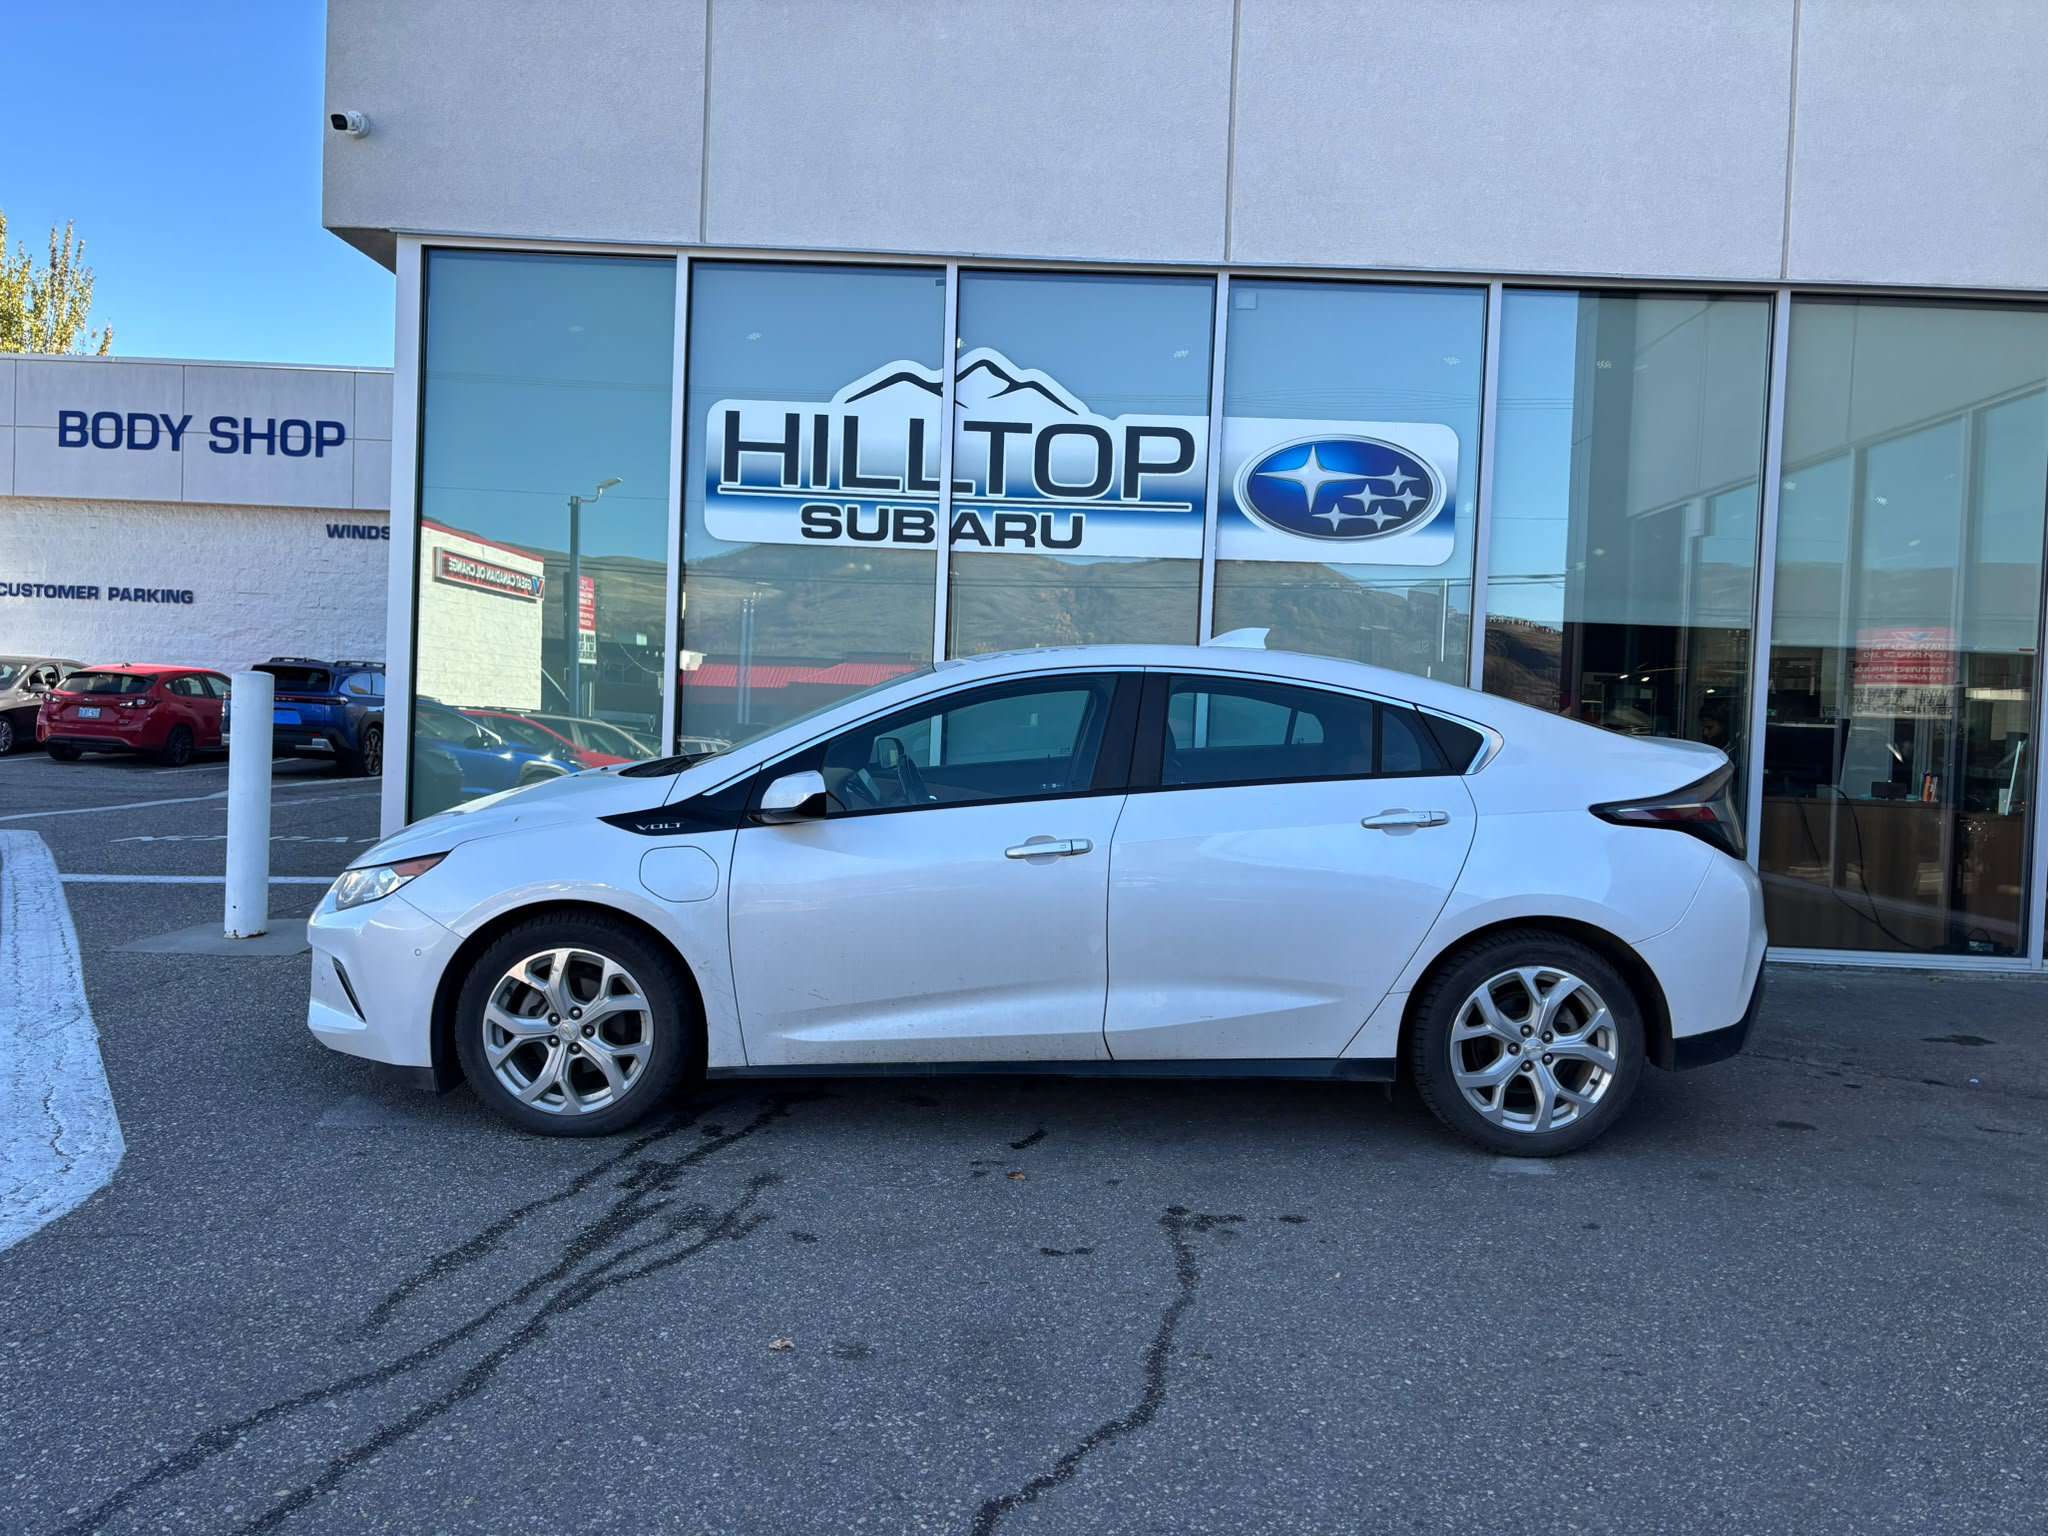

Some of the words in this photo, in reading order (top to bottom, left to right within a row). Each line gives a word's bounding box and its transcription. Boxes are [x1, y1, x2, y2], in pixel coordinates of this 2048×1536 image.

[59, 410, 192, 451] BODY
[209, 416, 346, 457] SHOP
[722, 410, 1196, 499] HILLTOP
[801, 505, 1084, 549] SUBARU
[0, 582, 100, 600] CUSTOMER
[108, 586, 194, 604] PARKING
[635, 822, 682, 831] VOLT
